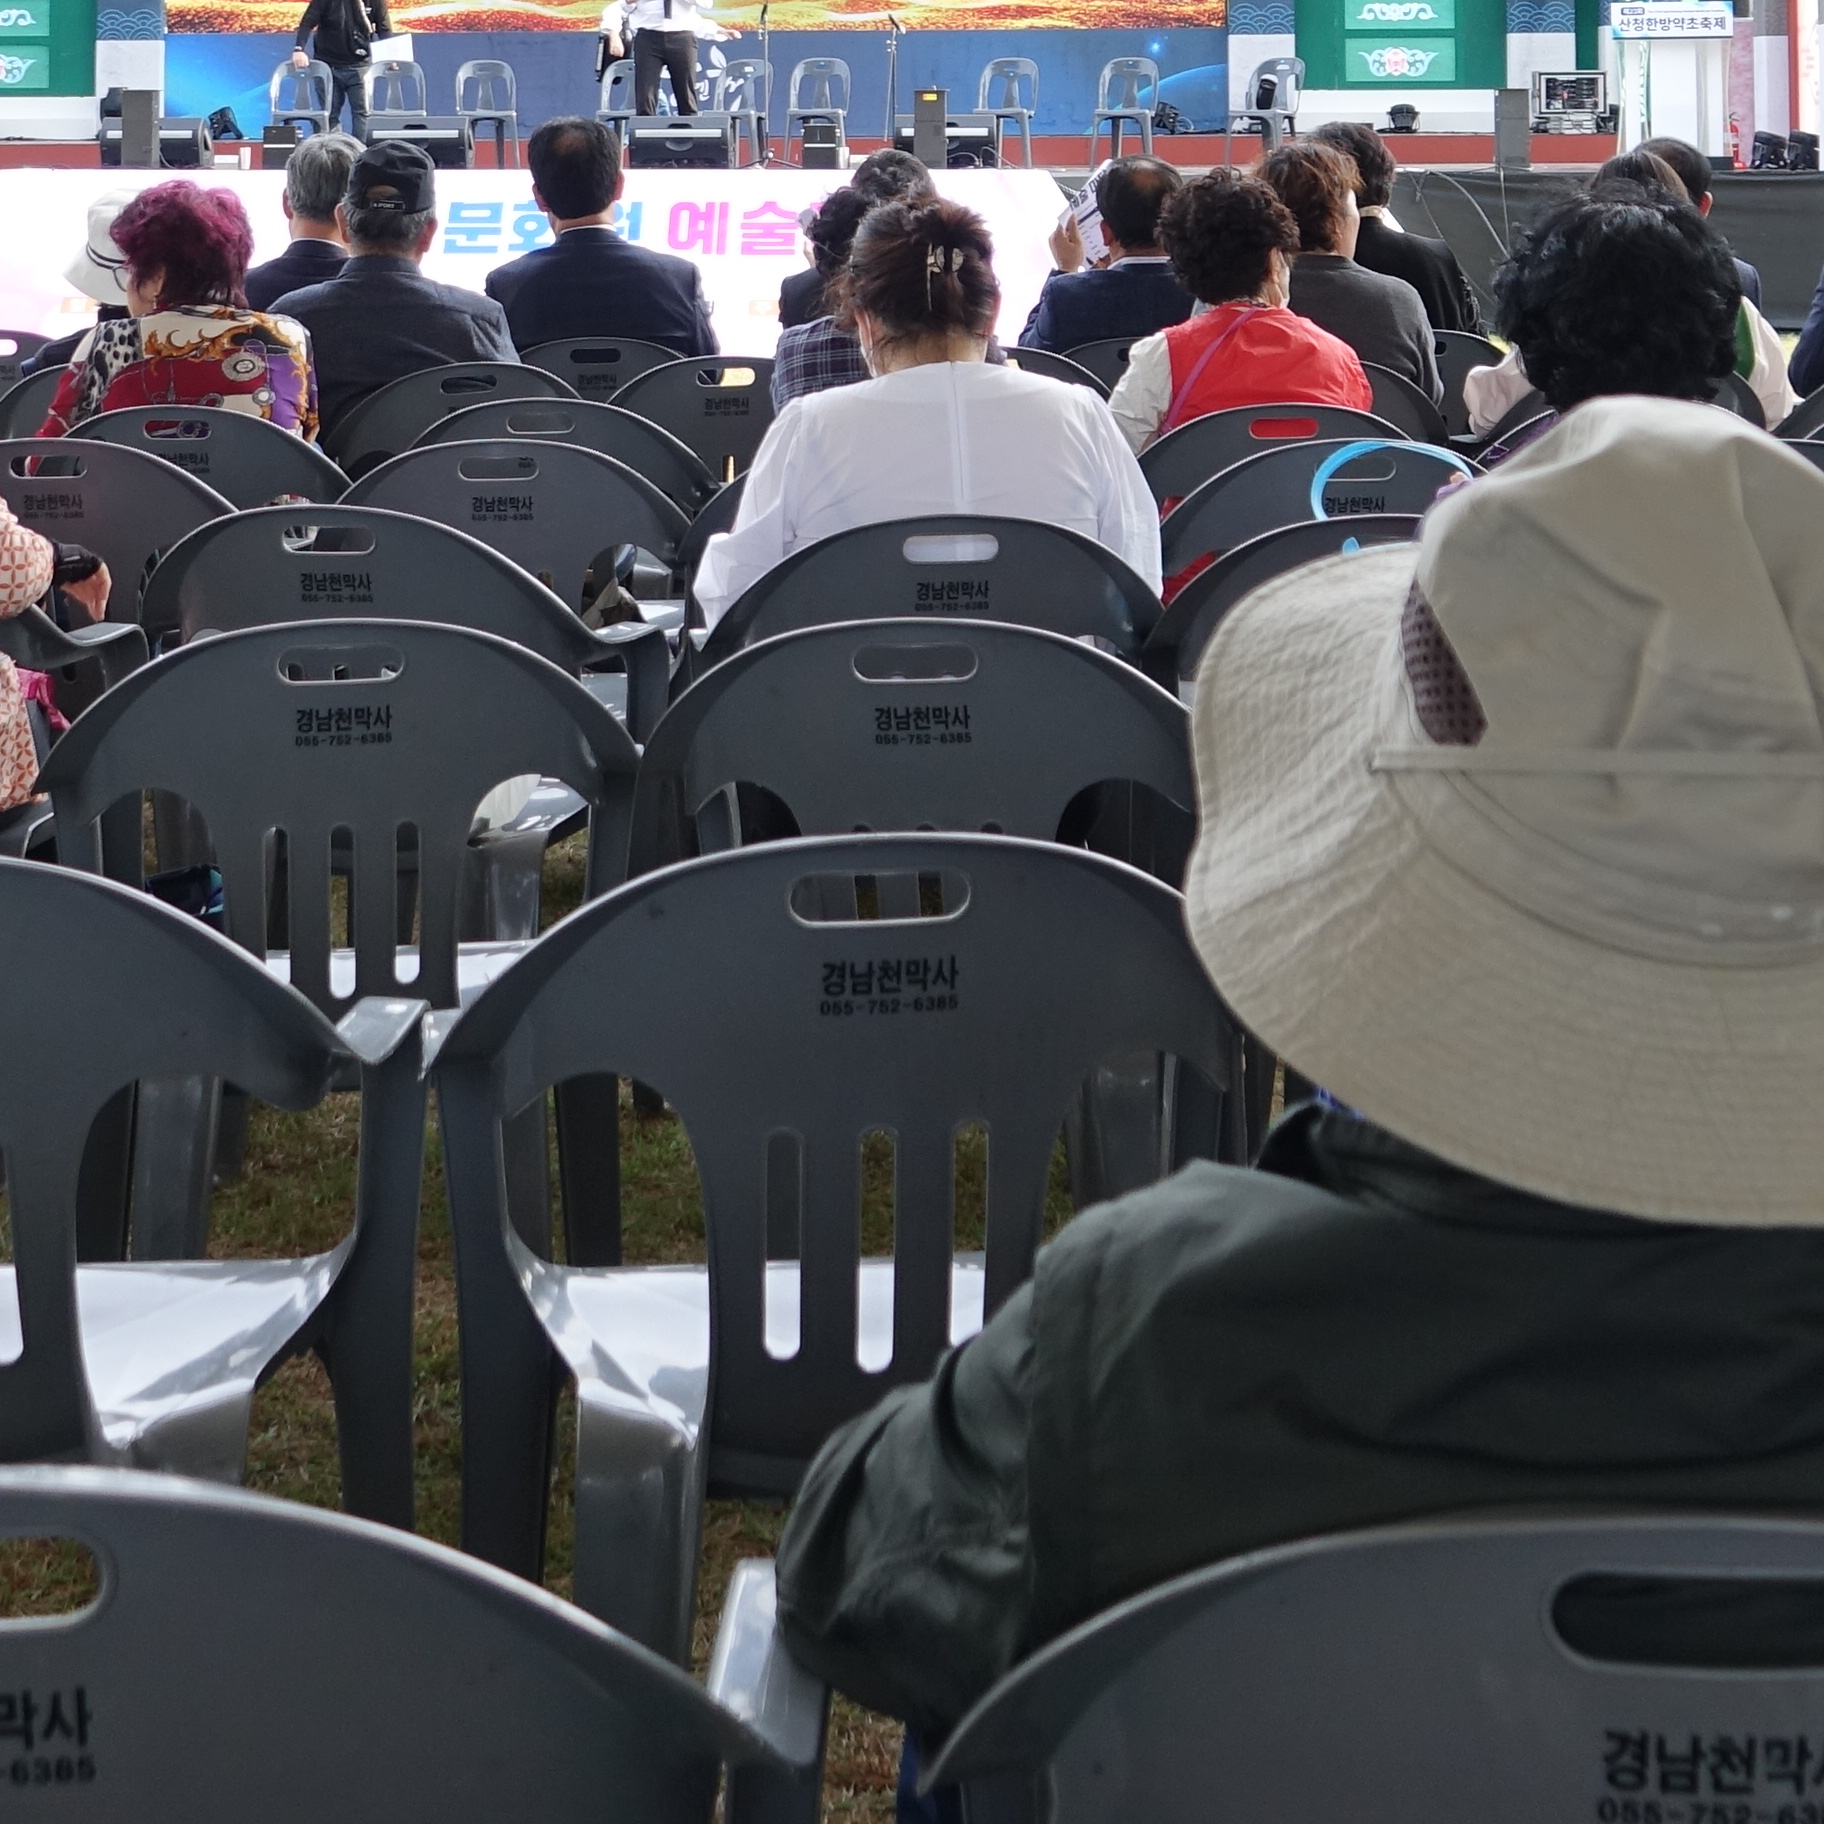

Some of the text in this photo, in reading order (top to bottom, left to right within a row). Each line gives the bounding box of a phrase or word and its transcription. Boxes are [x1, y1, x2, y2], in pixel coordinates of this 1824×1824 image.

[1619, 16, 1727, 32] 산청한방약초축제
[471, 495, 534, 513] 경남천막사
[300, 572, 373, 593] 경남천막사
[916, 580, 990, 602] 경남천막사
[295, 703, 394, 733] 경남천막사
[874, 705, 972, 732] 경남천막사
[294, 732, 393, 747] 055-752-6385
[875, 732, 973, 746] 055-752-6385
[821, 954, 960, 996] 경남천막사
[819, 995, 959, 1017] 055-752-6385
